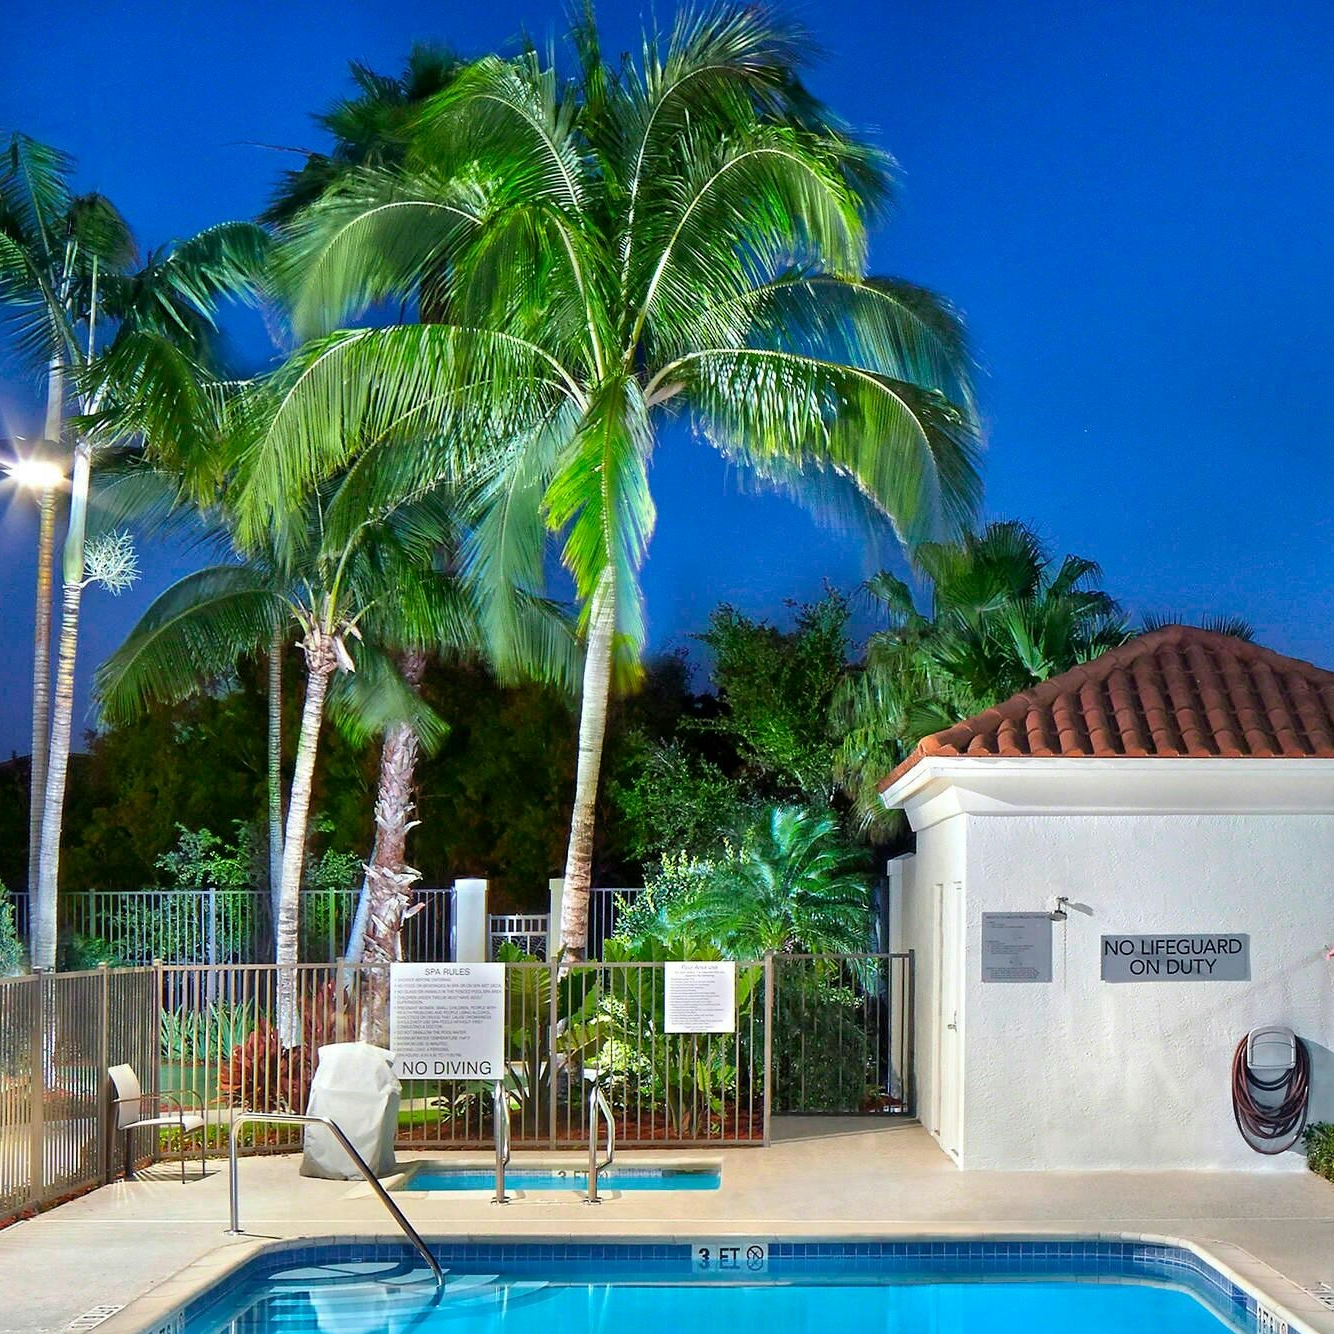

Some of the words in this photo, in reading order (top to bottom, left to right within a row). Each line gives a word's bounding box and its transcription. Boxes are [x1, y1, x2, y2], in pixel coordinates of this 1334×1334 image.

[1105, 940, 1134, 955] NO
[1141, 938, 1242, 955] LIFEGUARD
[425, 967, 441, 976] SPA
[443, 967, 471, 976] RULES
[1130, 959, 1159, 975] ON
[1167, 958, 1217, 975] DUTY
[402, 1061, 427, 1075] NO
[434, 1061, 492, 1075] DIVING
